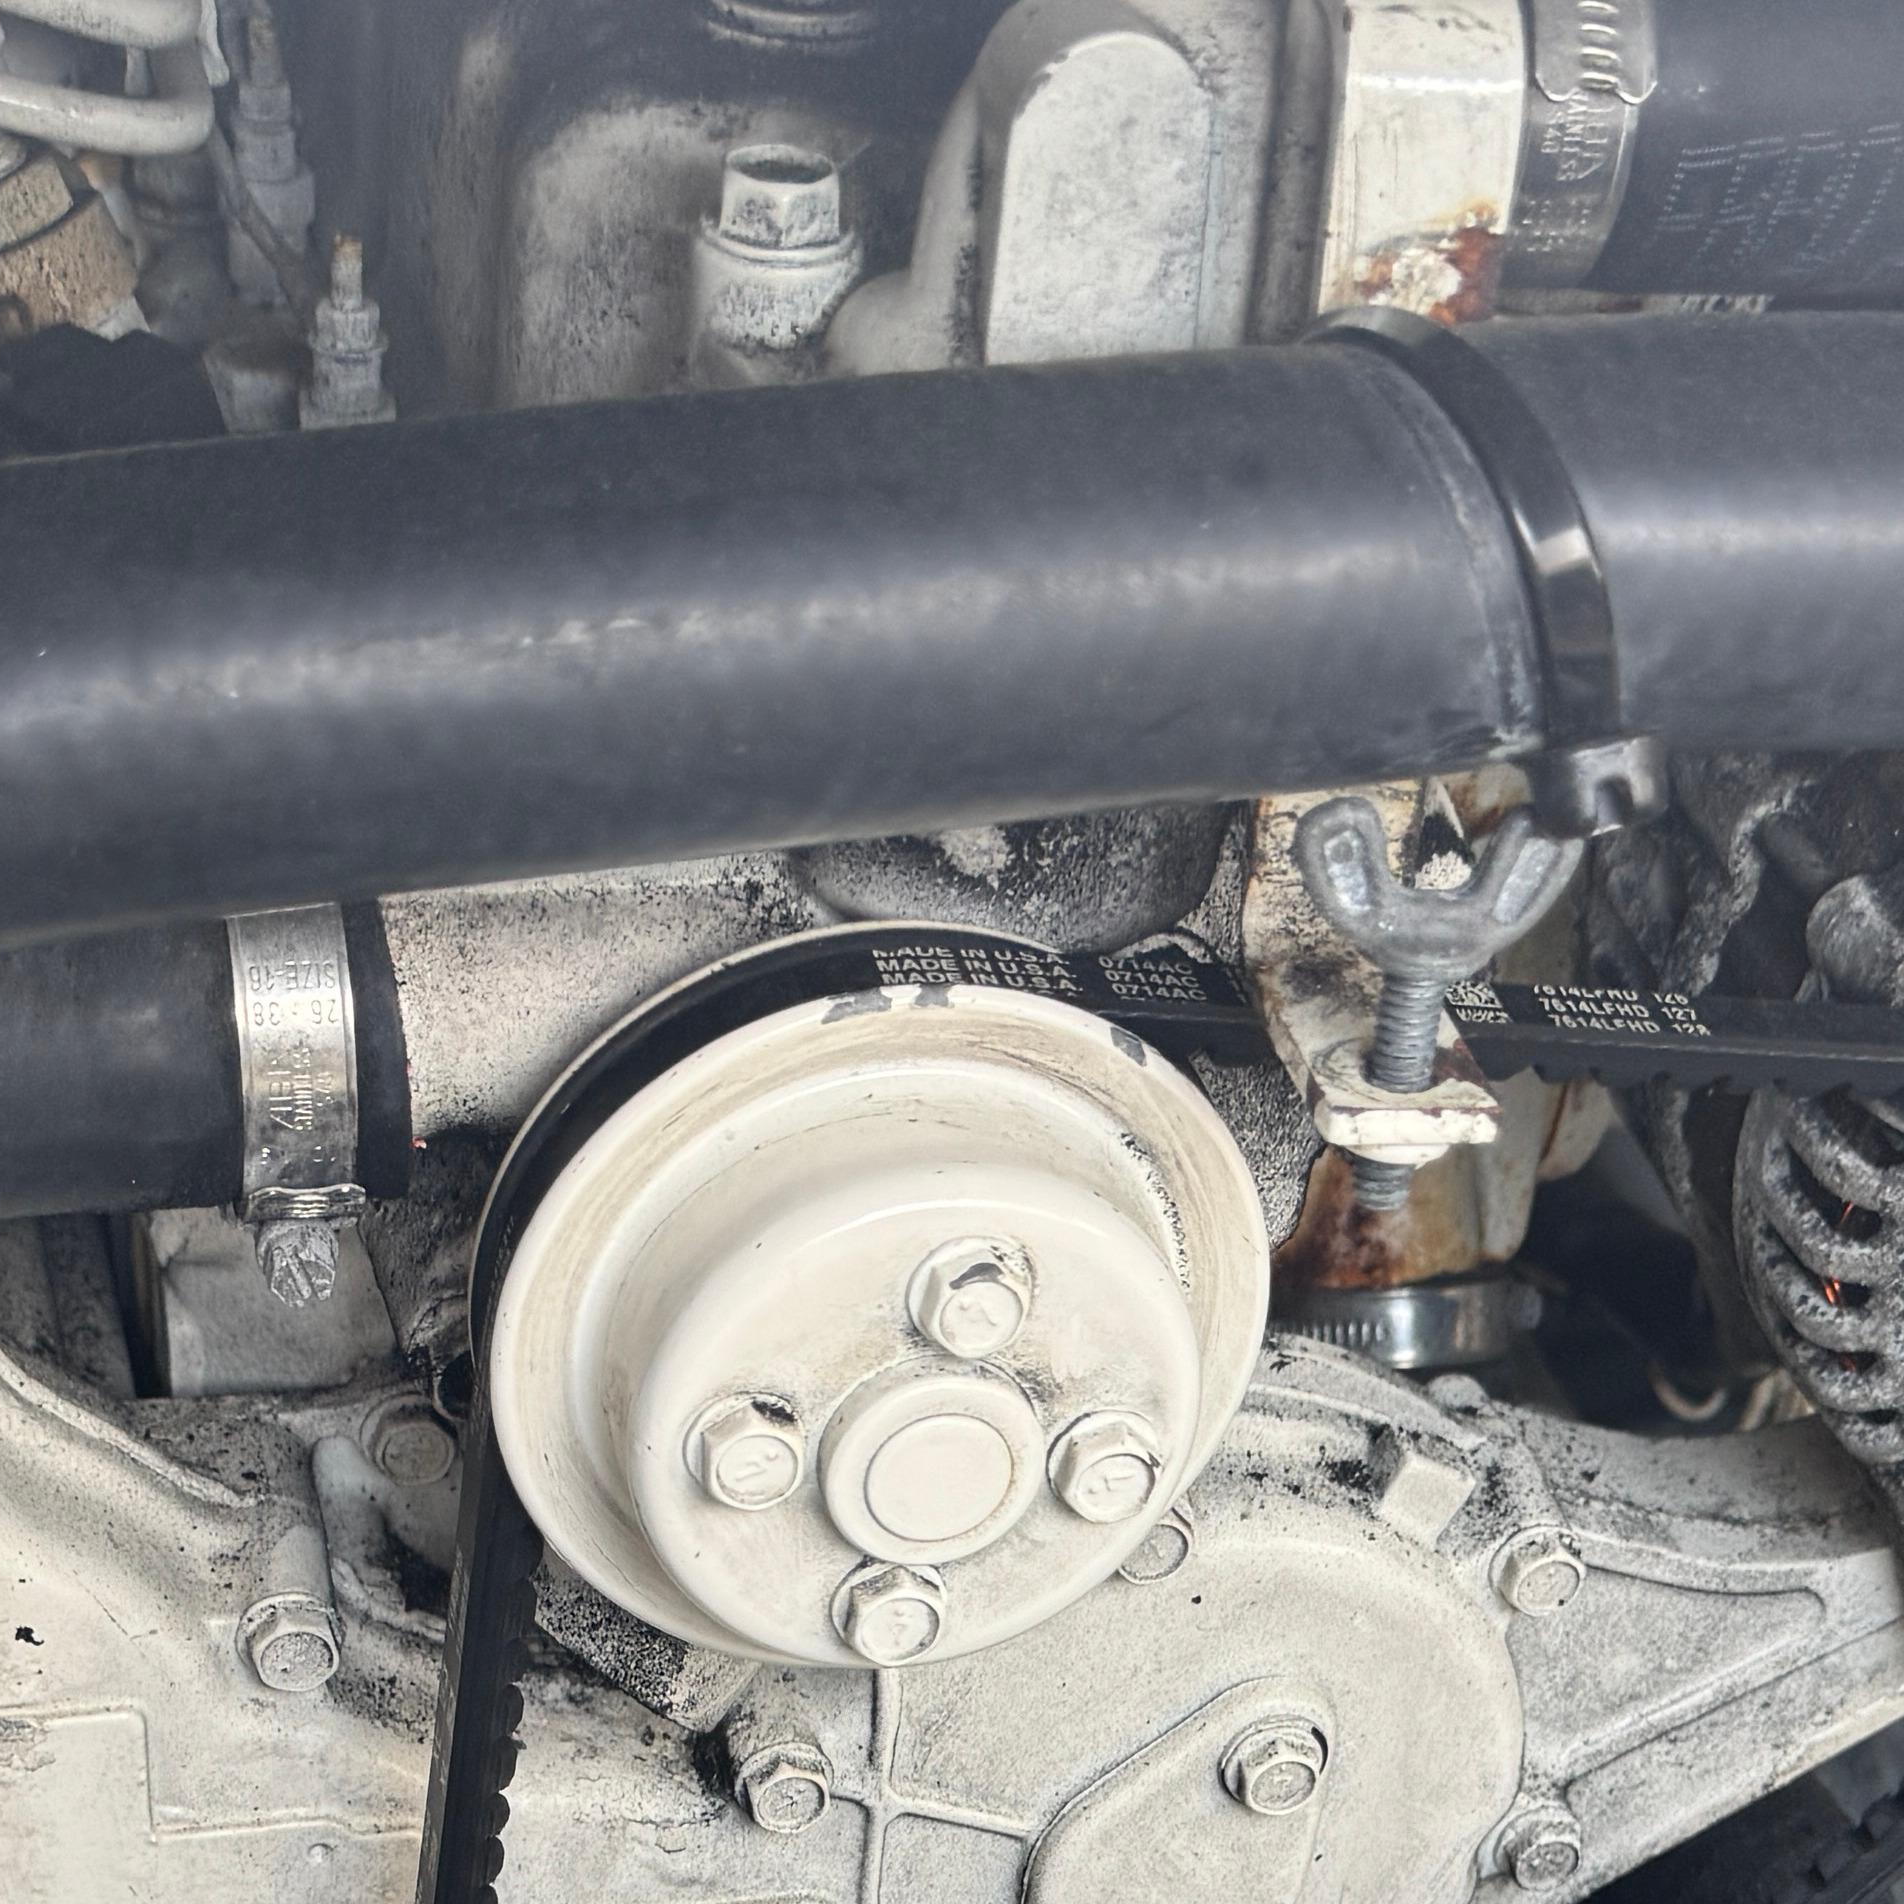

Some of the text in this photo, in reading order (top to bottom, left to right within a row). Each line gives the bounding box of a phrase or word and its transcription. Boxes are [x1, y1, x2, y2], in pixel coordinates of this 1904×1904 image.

[876, 959, 1200, 988] MADE IN U.S.A. 0714AC
[881, 973, 964, 985] MADE
[970, 973, 999, 985] IN
[1005, 975, 1084, 992] U.S.A.
[1111, 983, 1208, 1001] 0714AC
[252, 1001, 280, 1026] 38
[310, 999, 338, 1024] 26
[1538, 997, 1697, 1022] 7614LFHD 127
[1547, 1013, 1661, 1034] 7614LFHD
